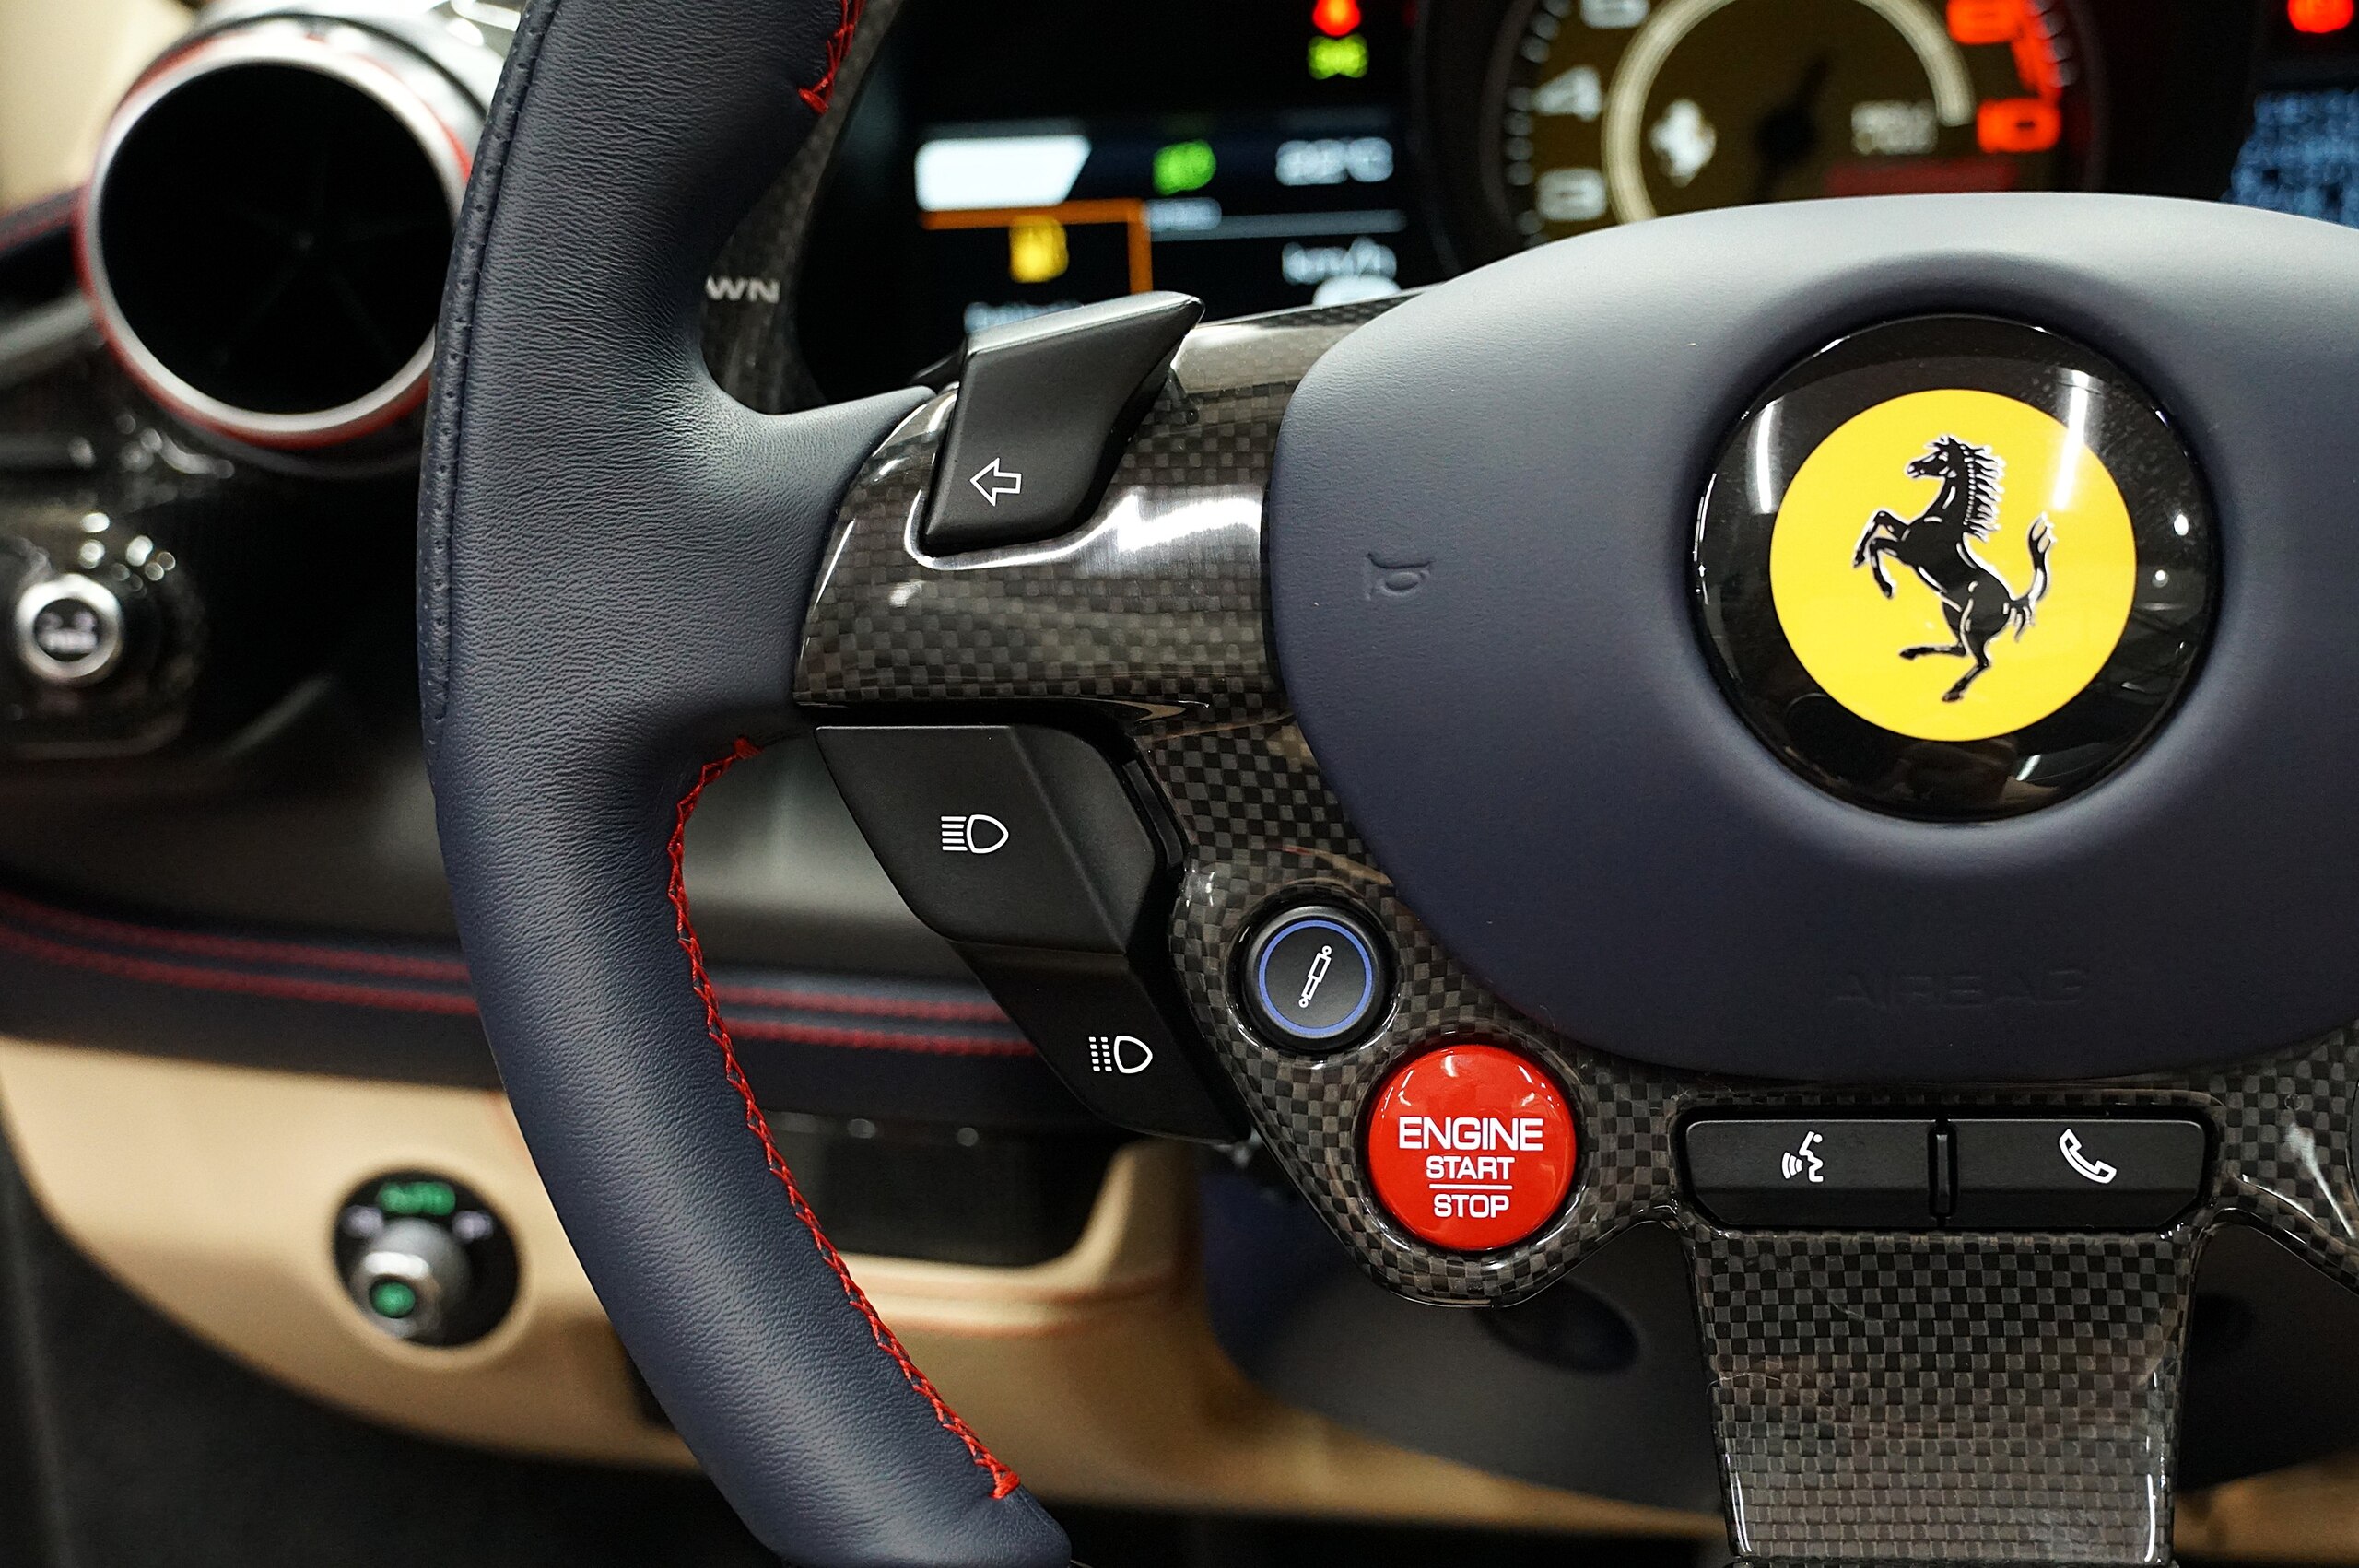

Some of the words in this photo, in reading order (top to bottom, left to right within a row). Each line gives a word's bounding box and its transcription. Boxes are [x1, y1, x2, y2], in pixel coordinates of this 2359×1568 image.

[1399, 1117, 1543, 1151] ENGINE
[1426, 1155, 1515, 1180] START
[1434, 1194, 1510, 1219] STOP
